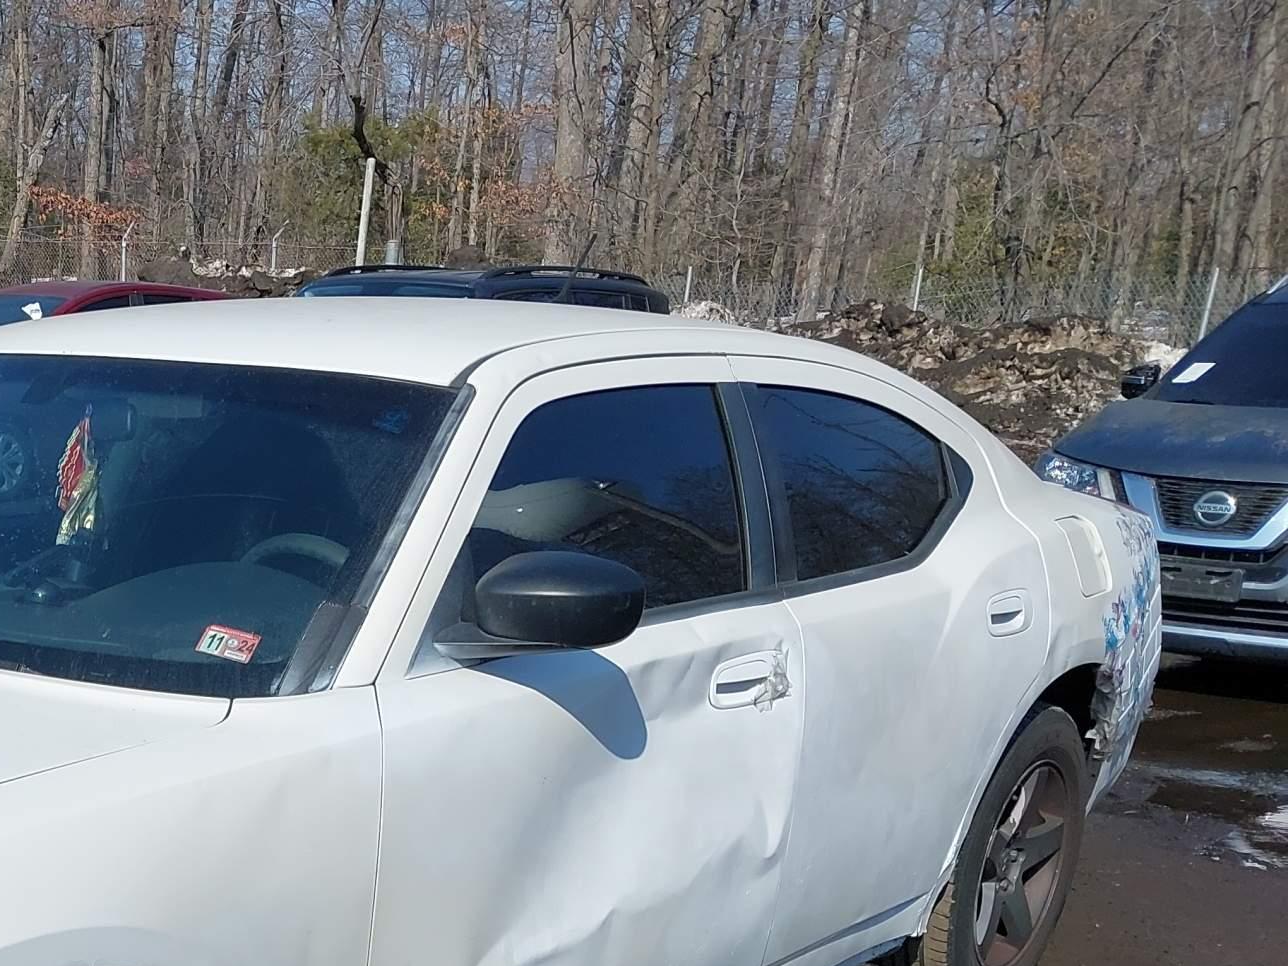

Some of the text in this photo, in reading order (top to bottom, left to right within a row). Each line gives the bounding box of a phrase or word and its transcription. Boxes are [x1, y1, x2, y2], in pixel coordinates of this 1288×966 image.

[1197, 504, 1231, 513] NISSAN
[207, 633, 225, 651] 11
[238, 640, 256, 655] 24
